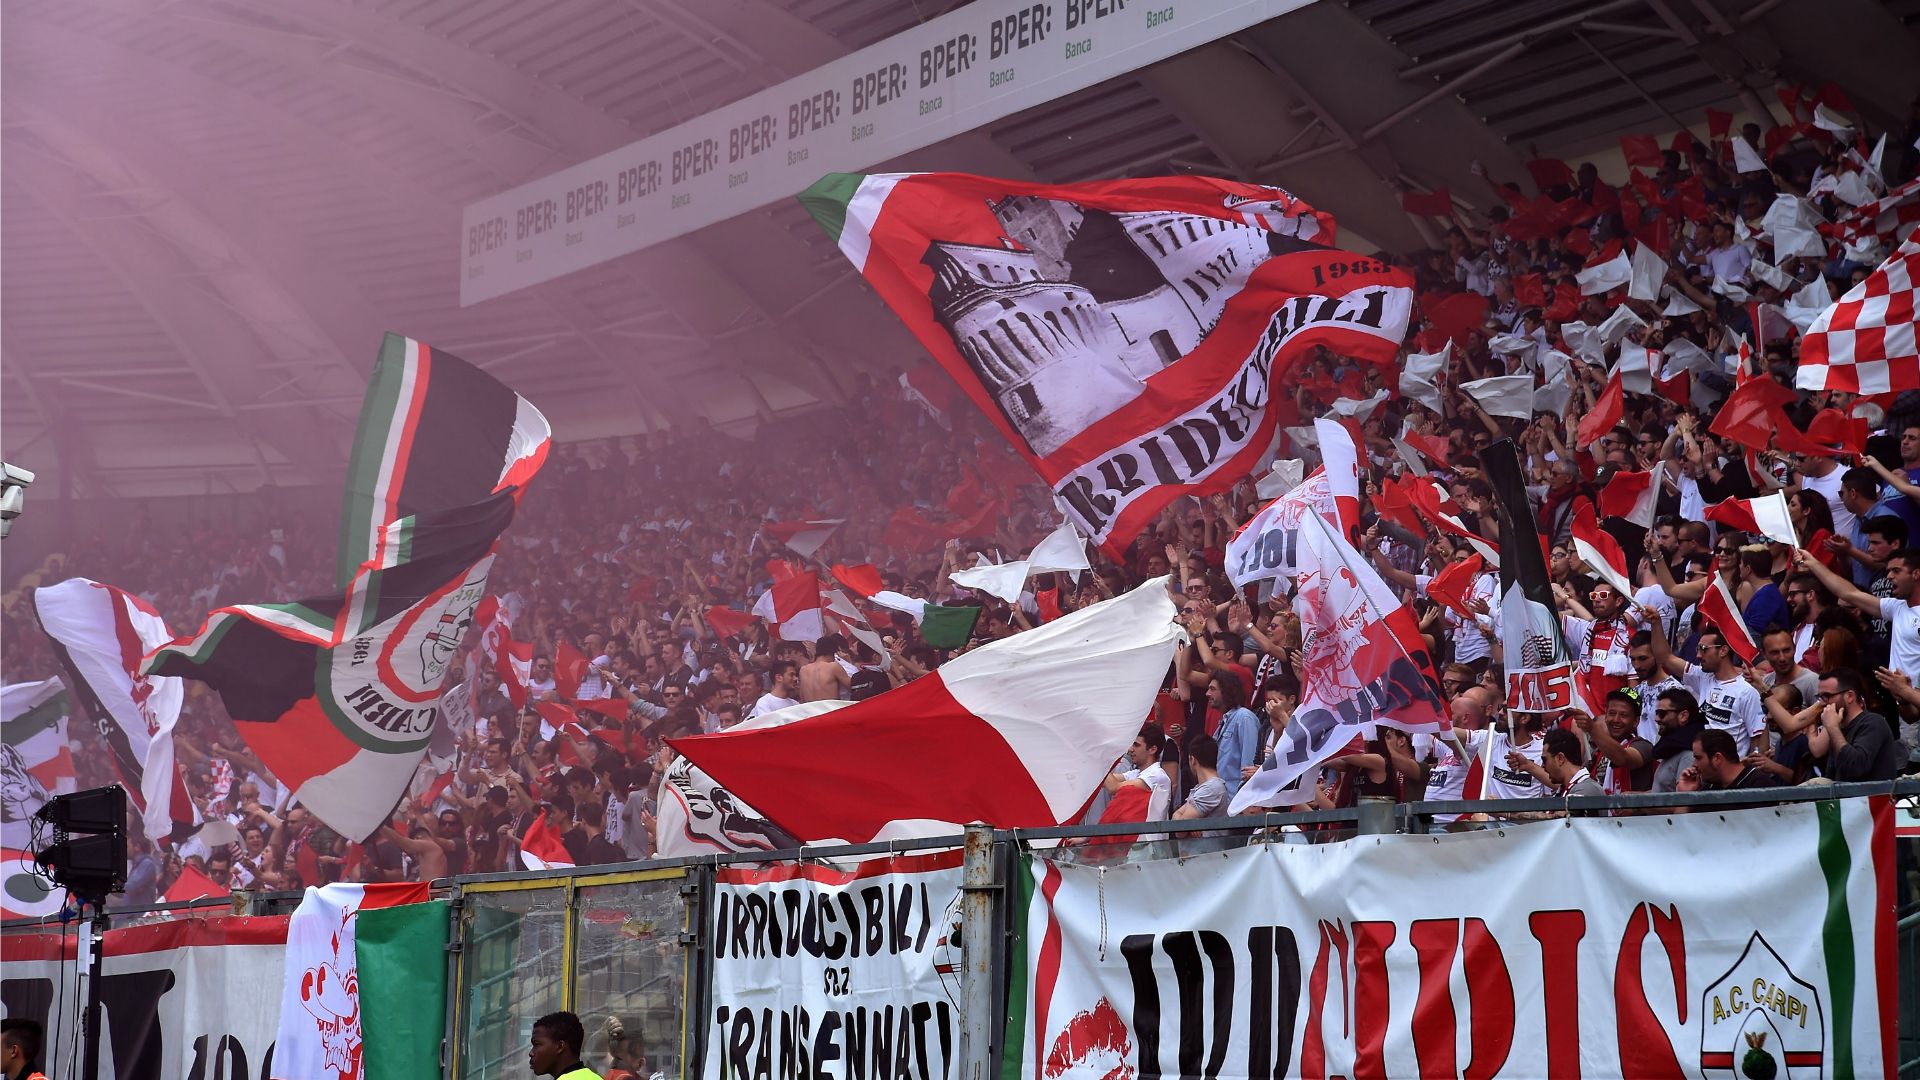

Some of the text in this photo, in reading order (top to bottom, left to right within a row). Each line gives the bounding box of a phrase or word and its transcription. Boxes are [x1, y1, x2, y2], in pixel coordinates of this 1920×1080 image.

[516, 200, 557, 240] BPER:
[566, 180, 608, 223] BPER:
[617, 160, 662, 204] BPER:
[672, 138, 718, 185] BPER:
[729, 115, 776, 163] BPER:
[788, 89, 840, 139] BPER:
[852, 62, 907, 115] BPER:
[920, 33, 976, 88] BPER:
[990, 3, 1051, 60] BPER:
[1066, 0, 1130, 30] BPE
[672, 192, 690, 210] Banca
[729, 170, 748, 188] Banca
[788, 146, 808, 166] Banca
[852, 120, 873, 142] Banca
[919, 96, 942, 116] Banca
[990, 66, 1014, 88] Banca
[1066, 38, 1092, 59] Banca
[1147, 6, 1174, 29] Banca
[715, 882, 931, 960] IRRIDUCIBILI
[716, 1001, 952, 1080] TRANSENNATI
[1713, 978, 1808, 1029] A.C. CARPI
